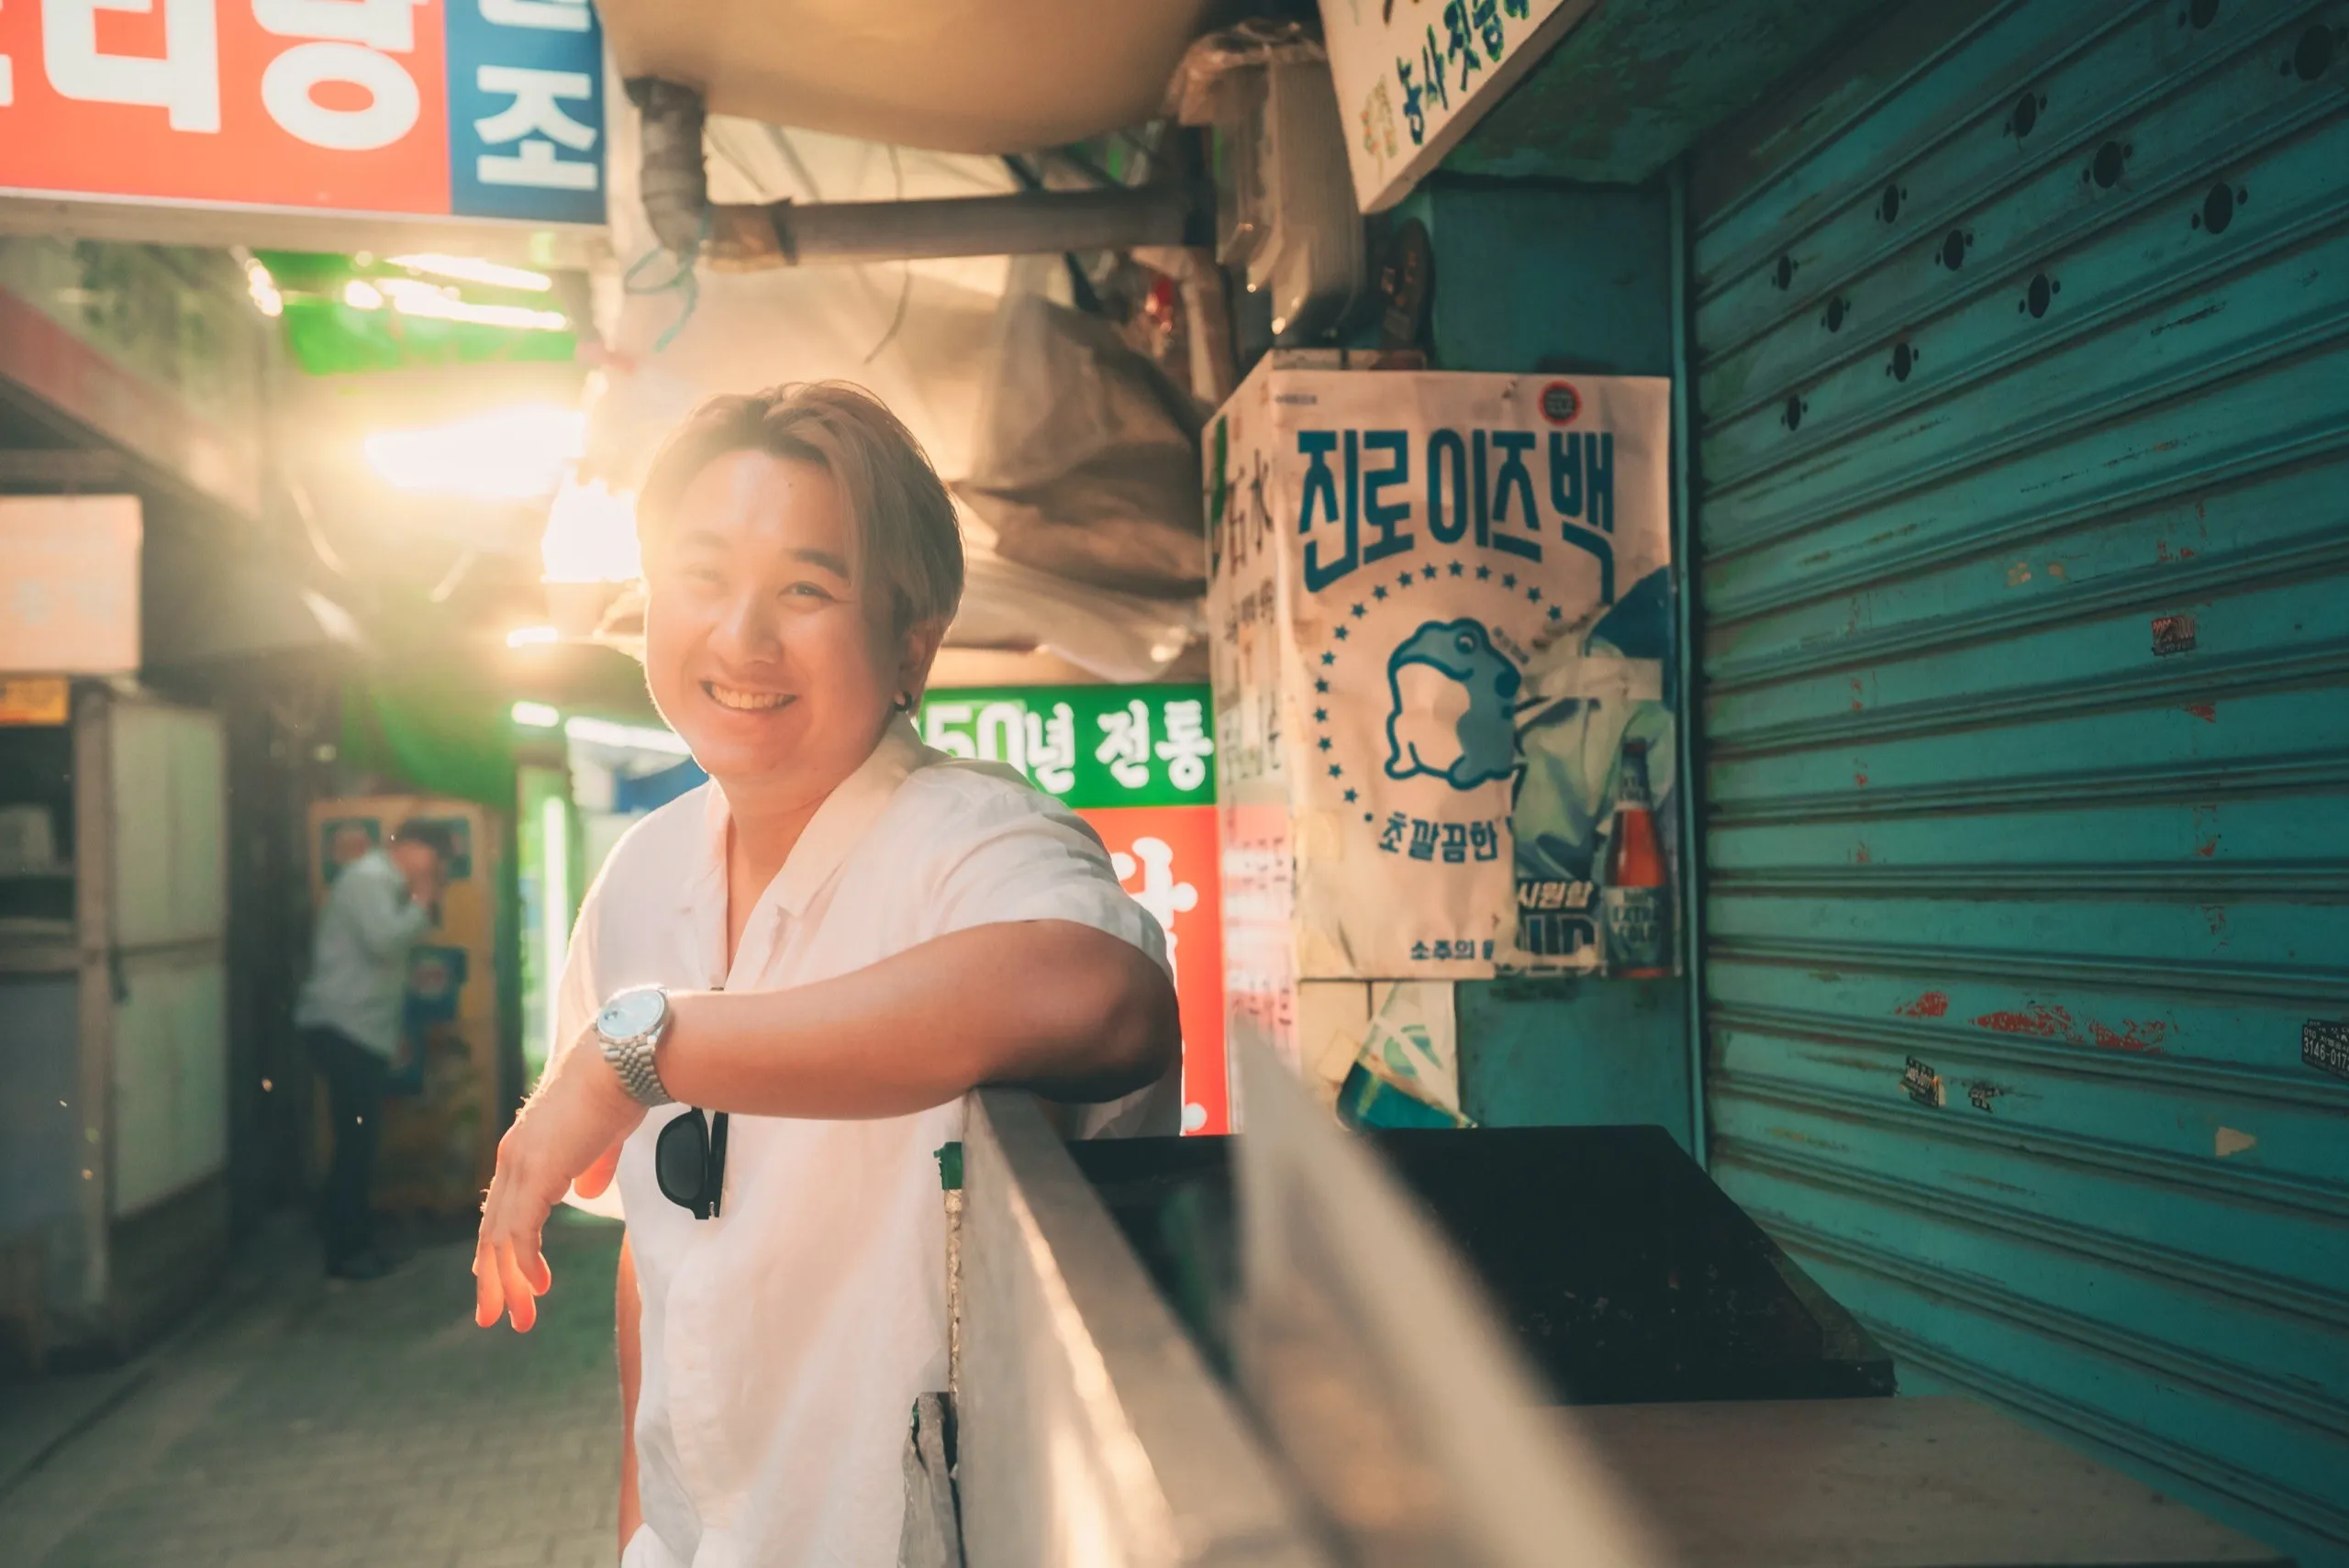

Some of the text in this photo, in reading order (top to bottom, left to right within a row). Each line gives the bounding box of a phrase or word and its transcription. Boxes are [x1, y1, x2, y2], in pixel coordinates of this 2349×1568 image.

[473, 0, 598, 191] 조
[1297, 428, 1615, 606] 진로이즈백
[925, 701, 1076, 795] 50년
[1095, 699, 1215, 791] 전통
[1378, 811, 1498, 864] 초깔끔한
[1410, 940, 1475, 961] 소주의
